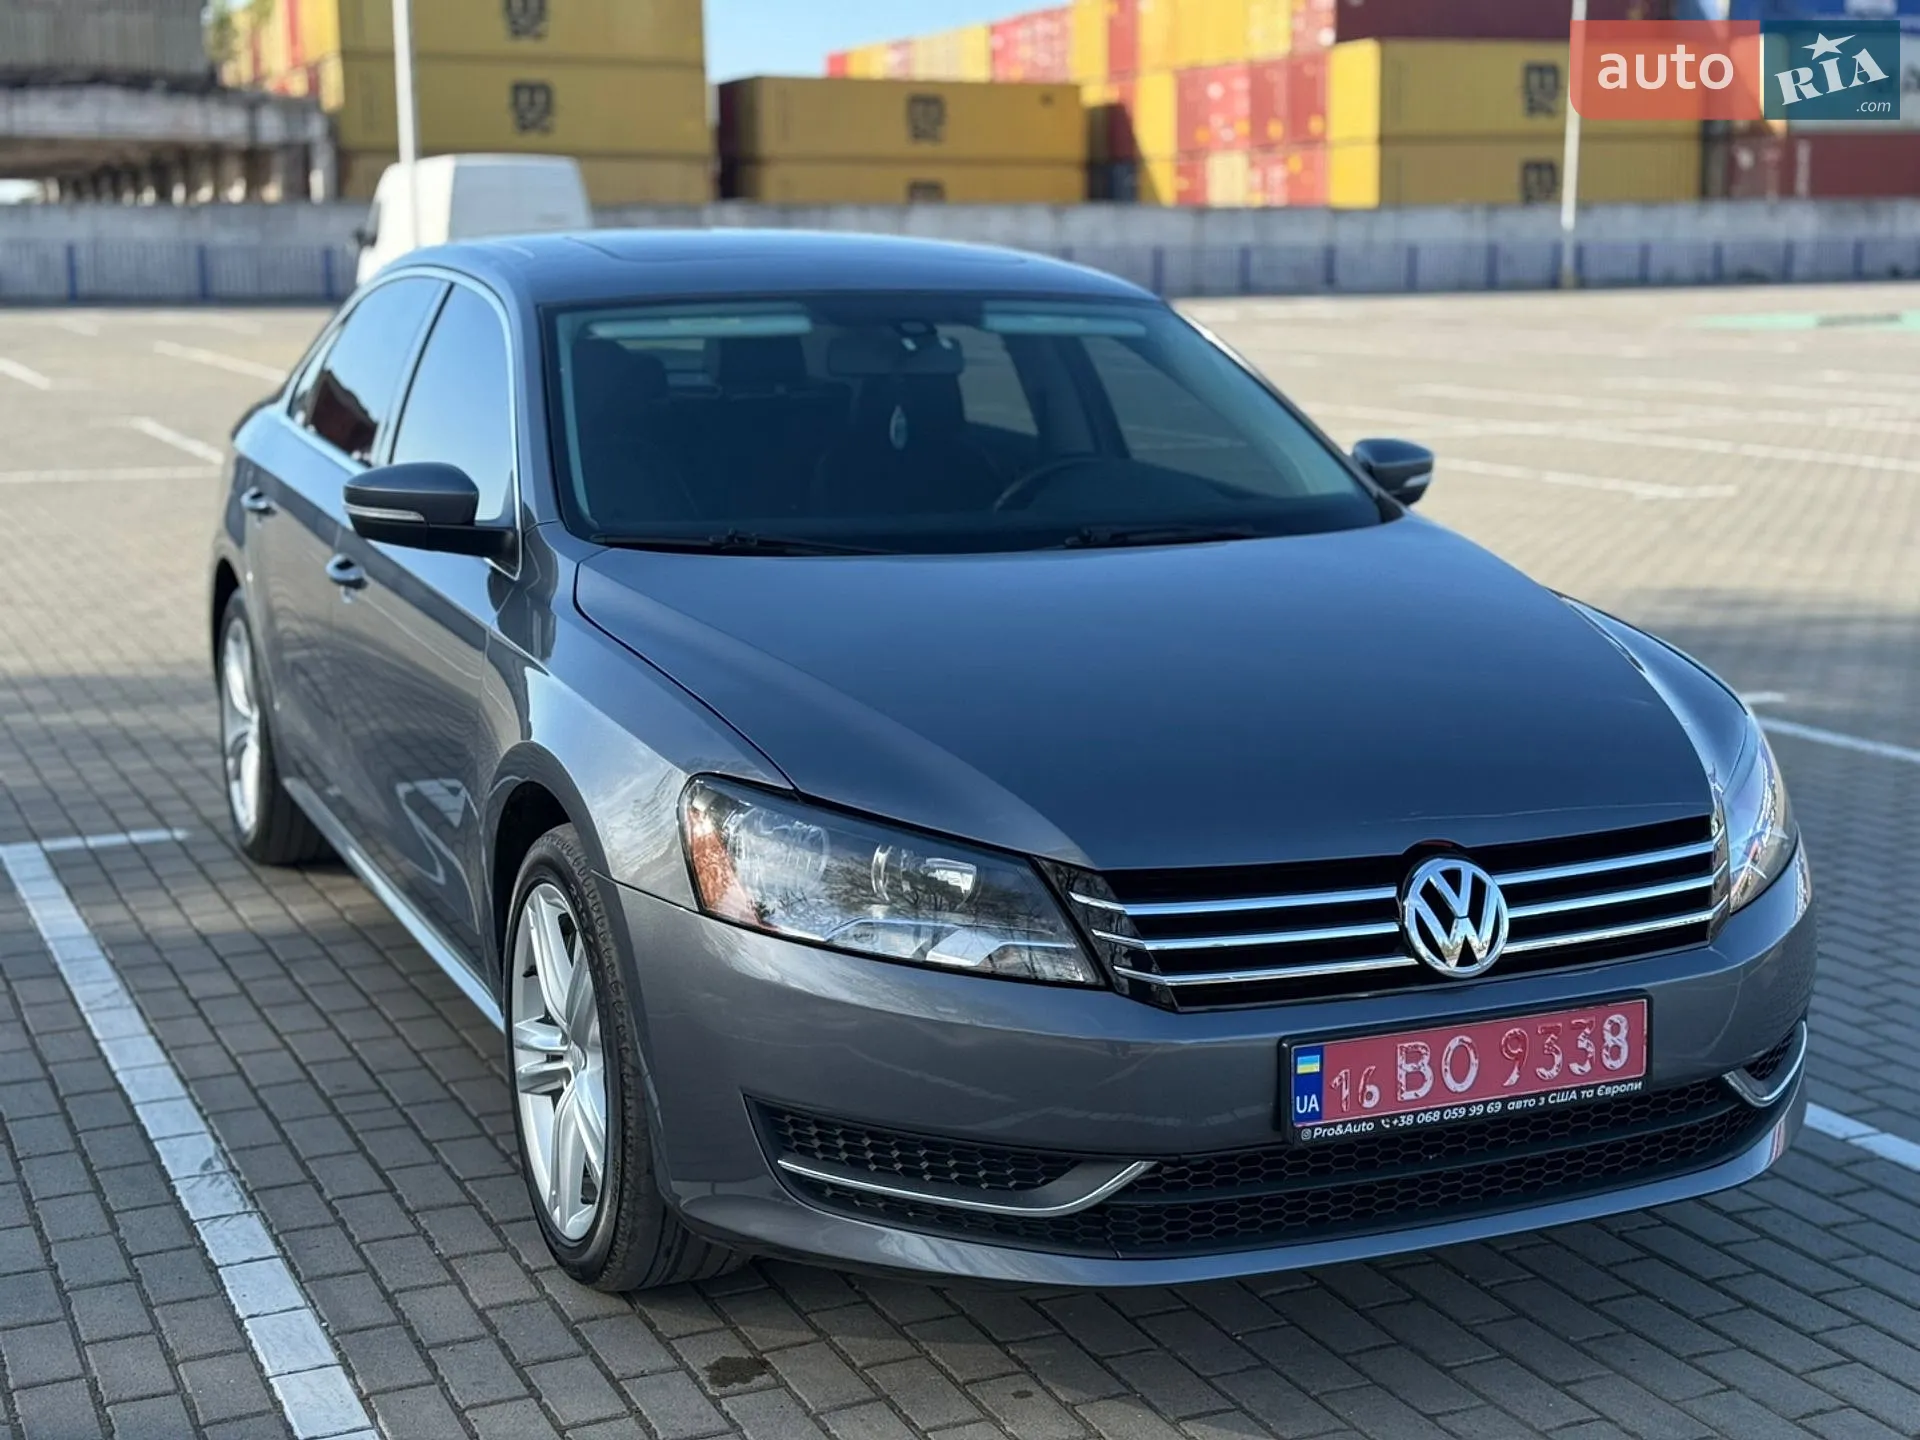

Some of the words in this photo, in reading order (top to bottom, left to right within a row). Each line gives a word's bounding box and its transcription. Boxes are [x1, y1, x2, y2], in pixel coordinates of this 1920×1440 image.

[1408, 862, 1505, 973] VW
[1331, 1065, 1381, 1113] 16
[1501, 1013, 1630, 1087] 9338
[1295, 1094, 1320, 1114] UA
[1506, 1098, 1536, 1111] авто
[1548, 1089, 1578, 1104] США
[1581, 1088, 1595, 1100] та
[1597, 1080, 1643, 1098] Європи
[1312, 1120, 1375, 1139] Pro&Auto
[1392, 1114, 1414, 1128] +38
[1416, 1110, 1441, 1125] 068
[1442, 1106, 1466, 1121] 059
[1468, 1103, 1484, 1117] 99
[1486, 1100, 1502, 1114] 69
